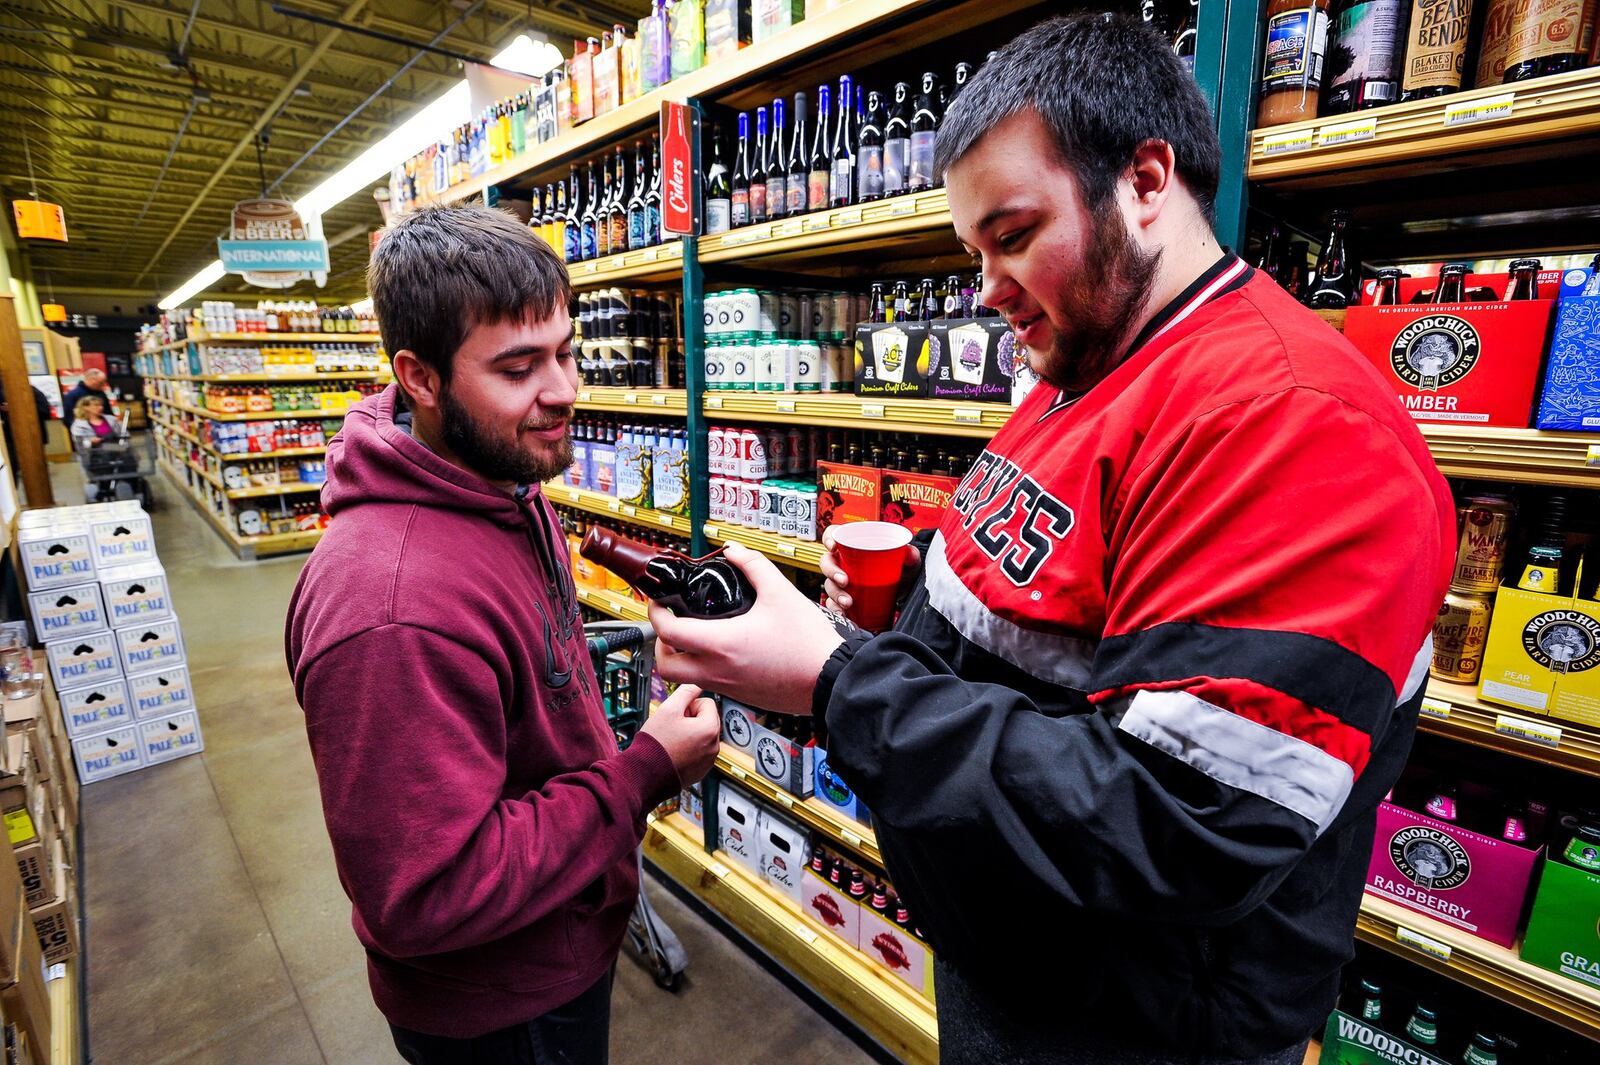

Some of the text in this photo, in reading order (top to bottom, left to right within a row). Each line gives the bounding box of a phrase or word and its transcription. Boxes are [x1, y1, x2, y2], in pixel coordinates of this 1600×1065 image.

[1418, 16, 1469, 47] BENDE
[1415, 54, 1451, 69] BLAKE'S
[668, 158, 688, 214] Ciders
[245, 228, 294, 240] BEER
[223, 249, 322, 263] INTERNATIONAL
[1394, 317, 1477, 351] WOODCHUCK
[1394, 354, 1475, 383] HARD CIDER
[861, 383, 919, 395] Premium Craft Ciders
[935, 383, 1005, 397] Premium Craft Ciders
[100, 540, 150, 557] PALE ALE
[33, 559, 91, 579] PALE ALE
[114, 598, 165, 617] PALE ALE
[42, 609, 97, 630] PALE ALE
[128, 644, 177, 664] PALE ALE
[1525, 637, 1549, 664] HARD
[60, 657, 114, 679] PALE ALE
[1504, 670, 1531, 682] PEAR
[138, 689, 187, 710] PALE ALE
[72, 704, 126, 727] PALE ALE
[149, 733, 196, 755] PALE ALE
[85, 749, 137, 772] PALE ALE
[1392, 808, 1420, 821] ORIGINAL
[1422, 819, 1454, 832] AMERICAN
[724, 834, 748, 858] Cidre
[1393, 829, 1468, 867] WOODCHUCK
[767, 862, 794, 888] Cidre
[1392, 848, 1465, 887] HARD CIDER
[1374, 875, 1471, 920] RASPBERRY
